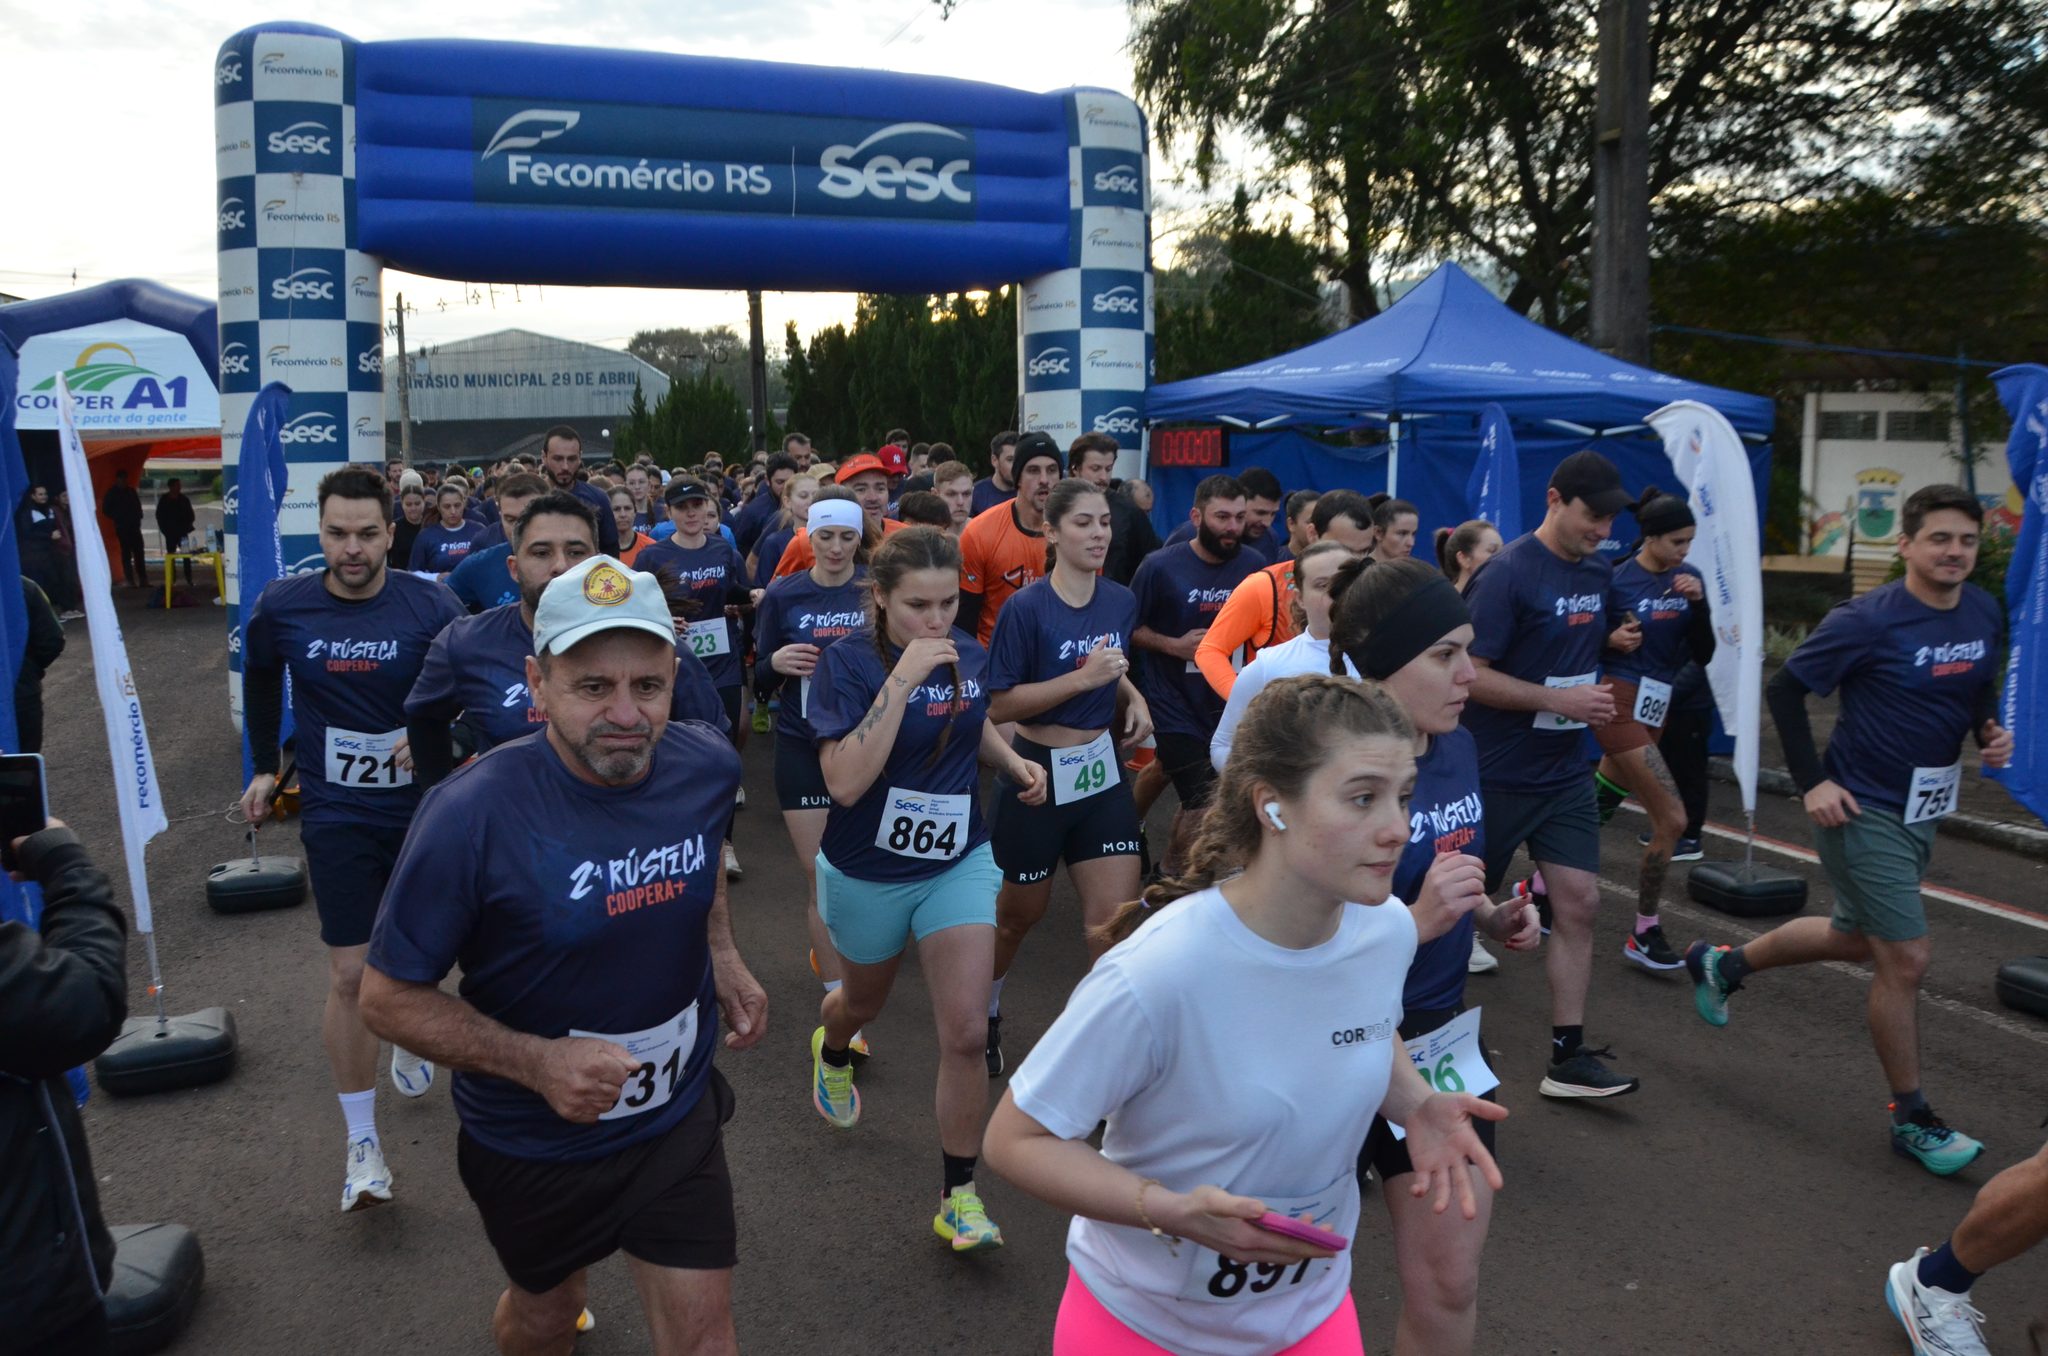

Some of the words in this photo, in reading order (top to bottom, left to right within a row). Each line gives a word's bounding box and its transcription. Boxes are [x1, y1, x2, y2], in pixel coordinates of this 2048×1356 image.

[217, 62, 242, 85] esc
[264, 64, 323, 77] Fecomércio
[325, 68, 338, 78] RS
[239, 139, 252, 150] RS
[267, 131, 331, 156] Sesc
[507, 154, 714, 192] Fecomércio
[725, 164, 772, 195] RS
[817, 143, 972, 204] Sesc
[267, 212, 324, 223] Fecomércio
[326, 213, 340, 224] RS
[243, 286, 254, 296] RS
[271, 277, 334, 300] Sesc
[271, 356, 328, 367] Fecomércio
[330, 356, 343, 367] RS
[464, 373, 547, 389] MUNICIPAL
[552, 372, 571, 387] 29
[575, 371, 594, 386] DE
[598, 370, 640, 386] ABRIL
[121, 375, 188, 410] A1
[82, 414, 120, 425] parte
[126, 412, 142, 424] da
[147, 412, 187, 426] gente
[691, 565, 726, 582] RÚSTICA
[815, 610, 865, 628] RÚSTICA
[329, 637, 398, 661] RÚSTICA
[692, 633, 718, 655] 23
[326, 659, 381, 672] COOPERA+
[335, 752, 398, 784] 721
[1074, 759, 1106, 793] 49
[801, 796, 831, 806] RUN
[1914, 783, 1954, 819] 759
[889, 816, 957, 856] 864
[1102, 840, 1140, 854] MORE
[608, 833, 706, 894] RÚSTICA
[1019, 868, 1048, 882] RUN
[606, 879, 687, 917] COOPERA+
[612, 1046, 681, 1112] 31
